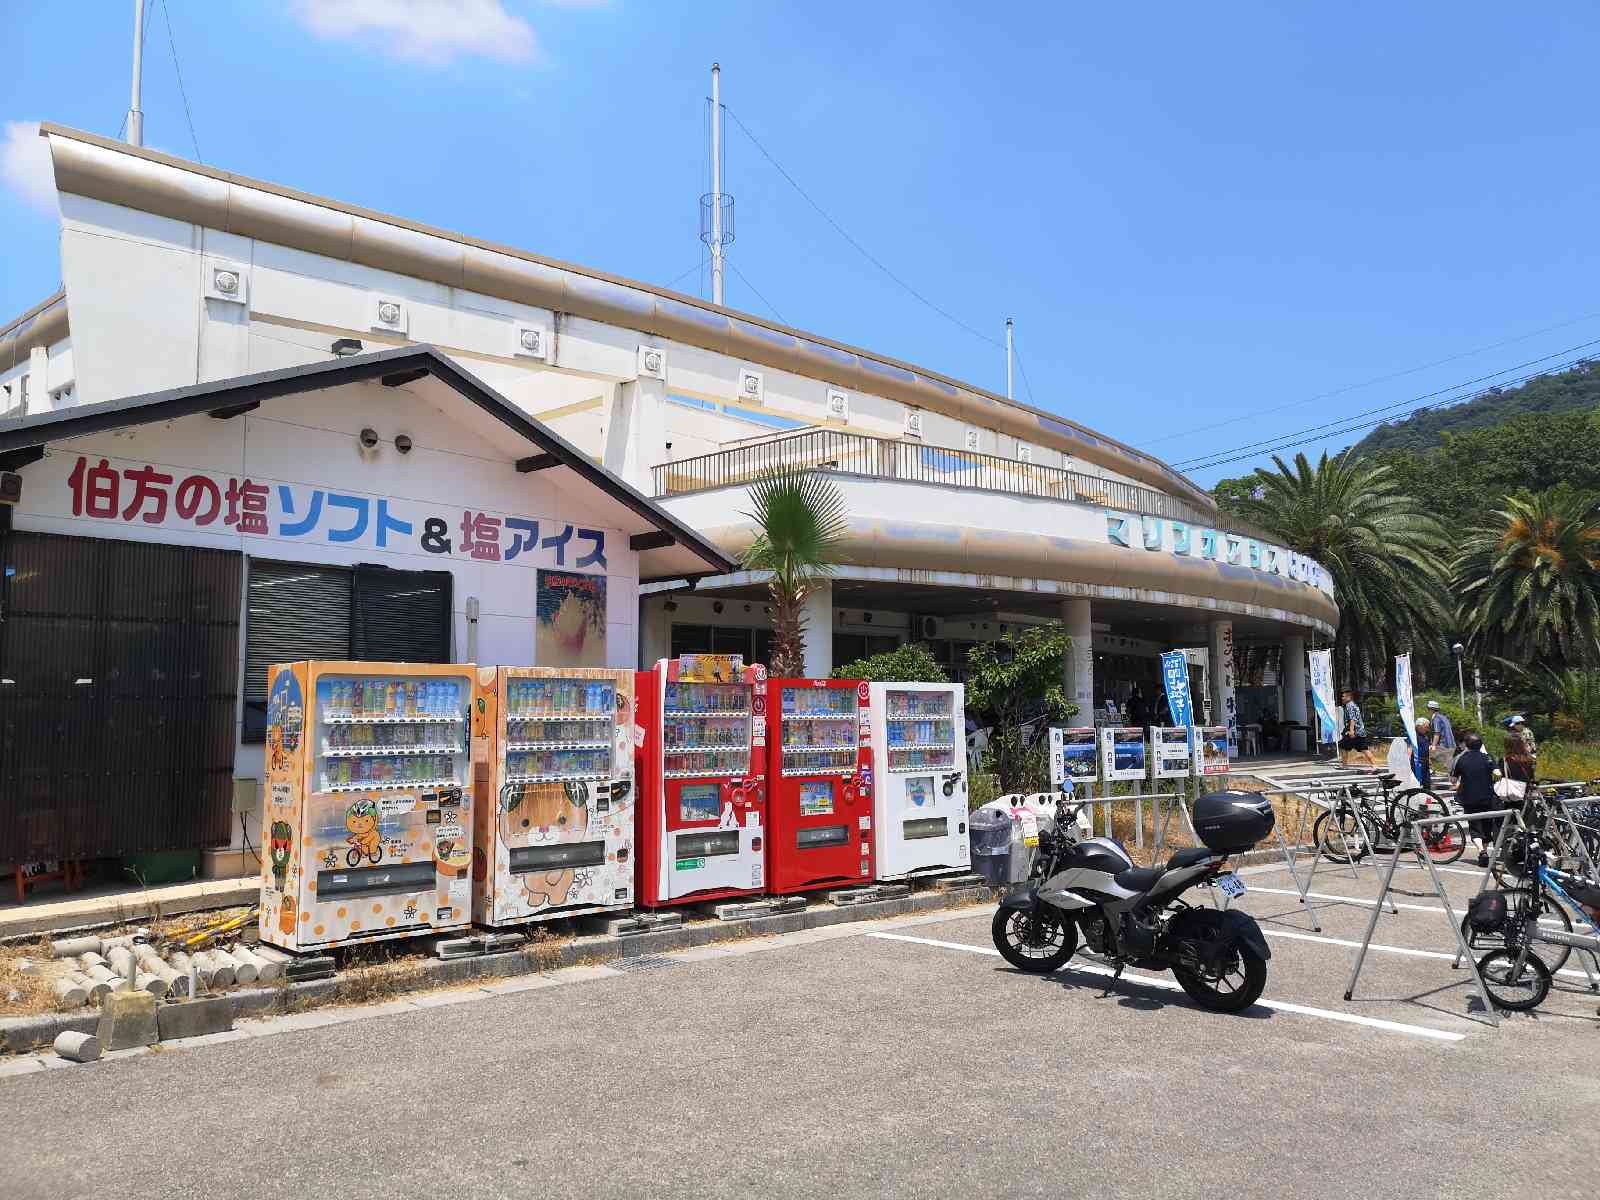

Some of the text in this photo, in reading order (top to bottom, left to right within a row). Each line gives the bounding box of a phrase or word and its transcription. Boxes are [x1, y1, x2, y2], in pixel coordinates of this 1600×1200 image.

[68, 456, 607, 571] 伯方の塩ソフト&塩アイス
